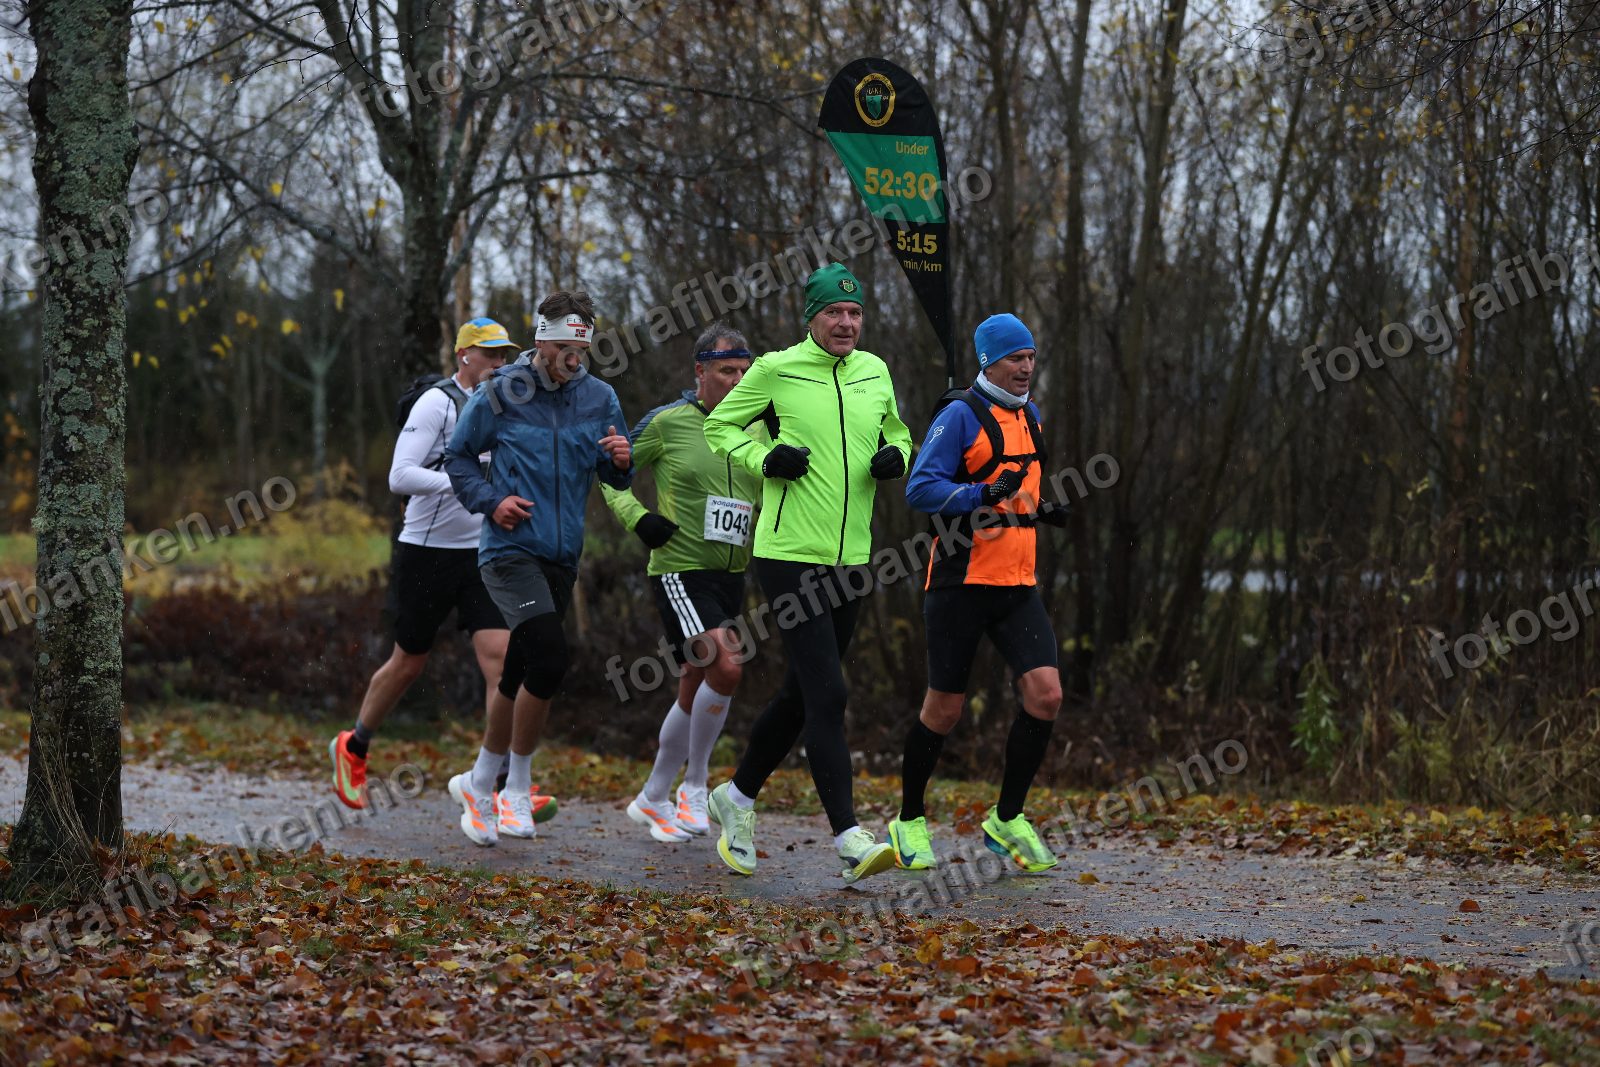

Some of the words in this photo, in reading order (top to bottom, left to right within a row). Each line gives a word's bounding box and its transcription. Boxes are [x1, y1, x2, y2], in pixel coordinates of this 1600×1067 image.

[895, 141, 929, 156] Under
[863, 167, 938, 200] 52:30
[896, 230, 938, 254] 5:15
[903, 259, 942, 273] min/km
[711, 508, 749, 537] 1043
